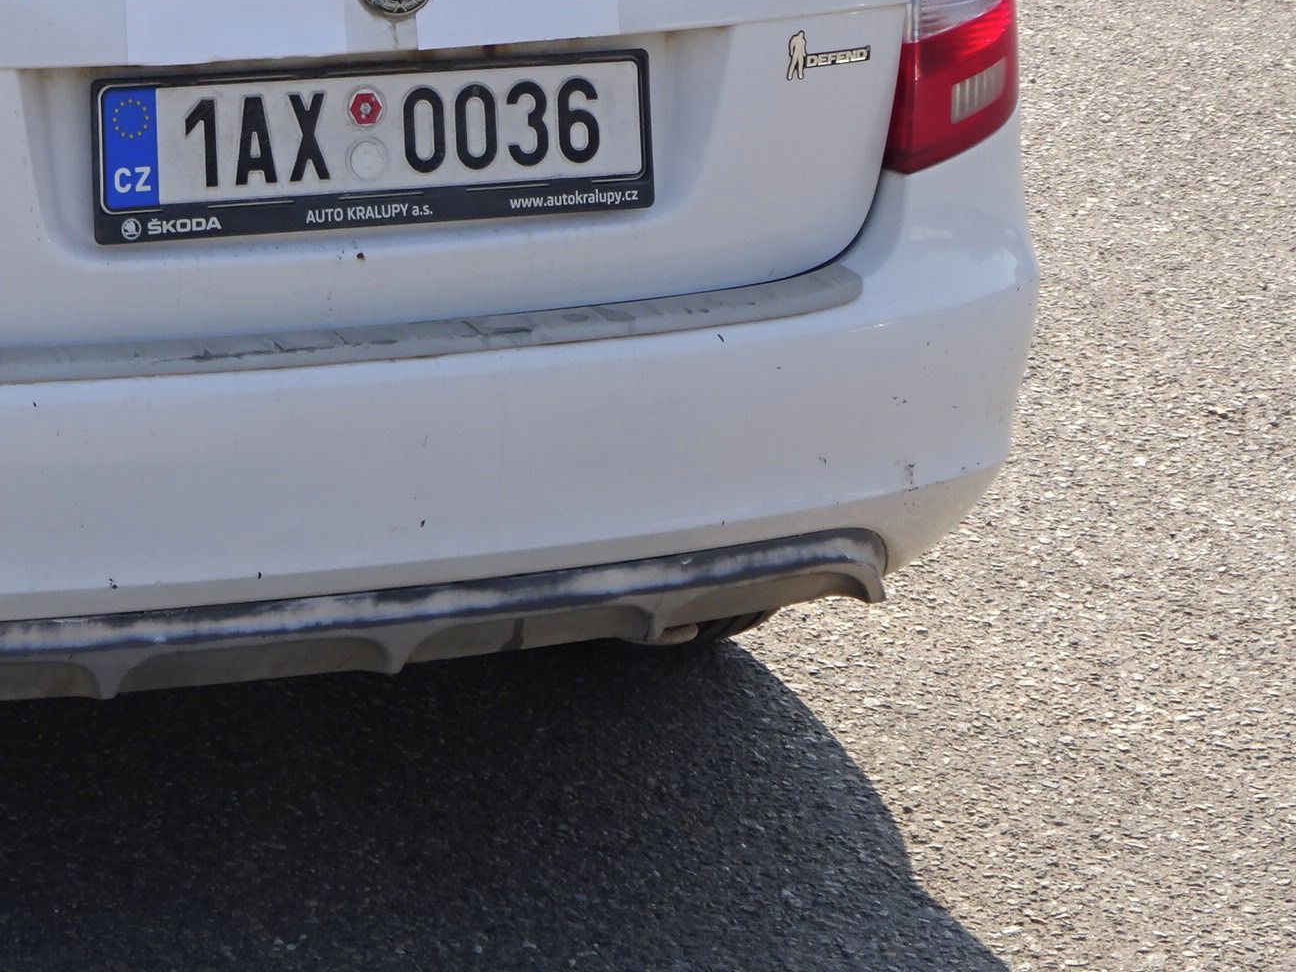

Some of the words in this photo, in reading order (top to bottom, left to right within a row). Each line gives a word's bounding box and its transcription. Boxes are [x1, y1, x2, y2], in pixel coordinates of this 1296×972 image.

[806, 48, 868, 68] DEFEND
[184, 91, 332, 188] 1AX
[403, 76, 602, 174] 0036
[113, 166, 152, 194] CZ
[510, 188, 639, 210] www.autokralupy.cz
[306, 207, 345, 224] AUTO
[347, 203, 408, 222] KRALUPY
[411, 206, 434, 217] a.s.
[147, 216, 222, 236] ŠKODA
